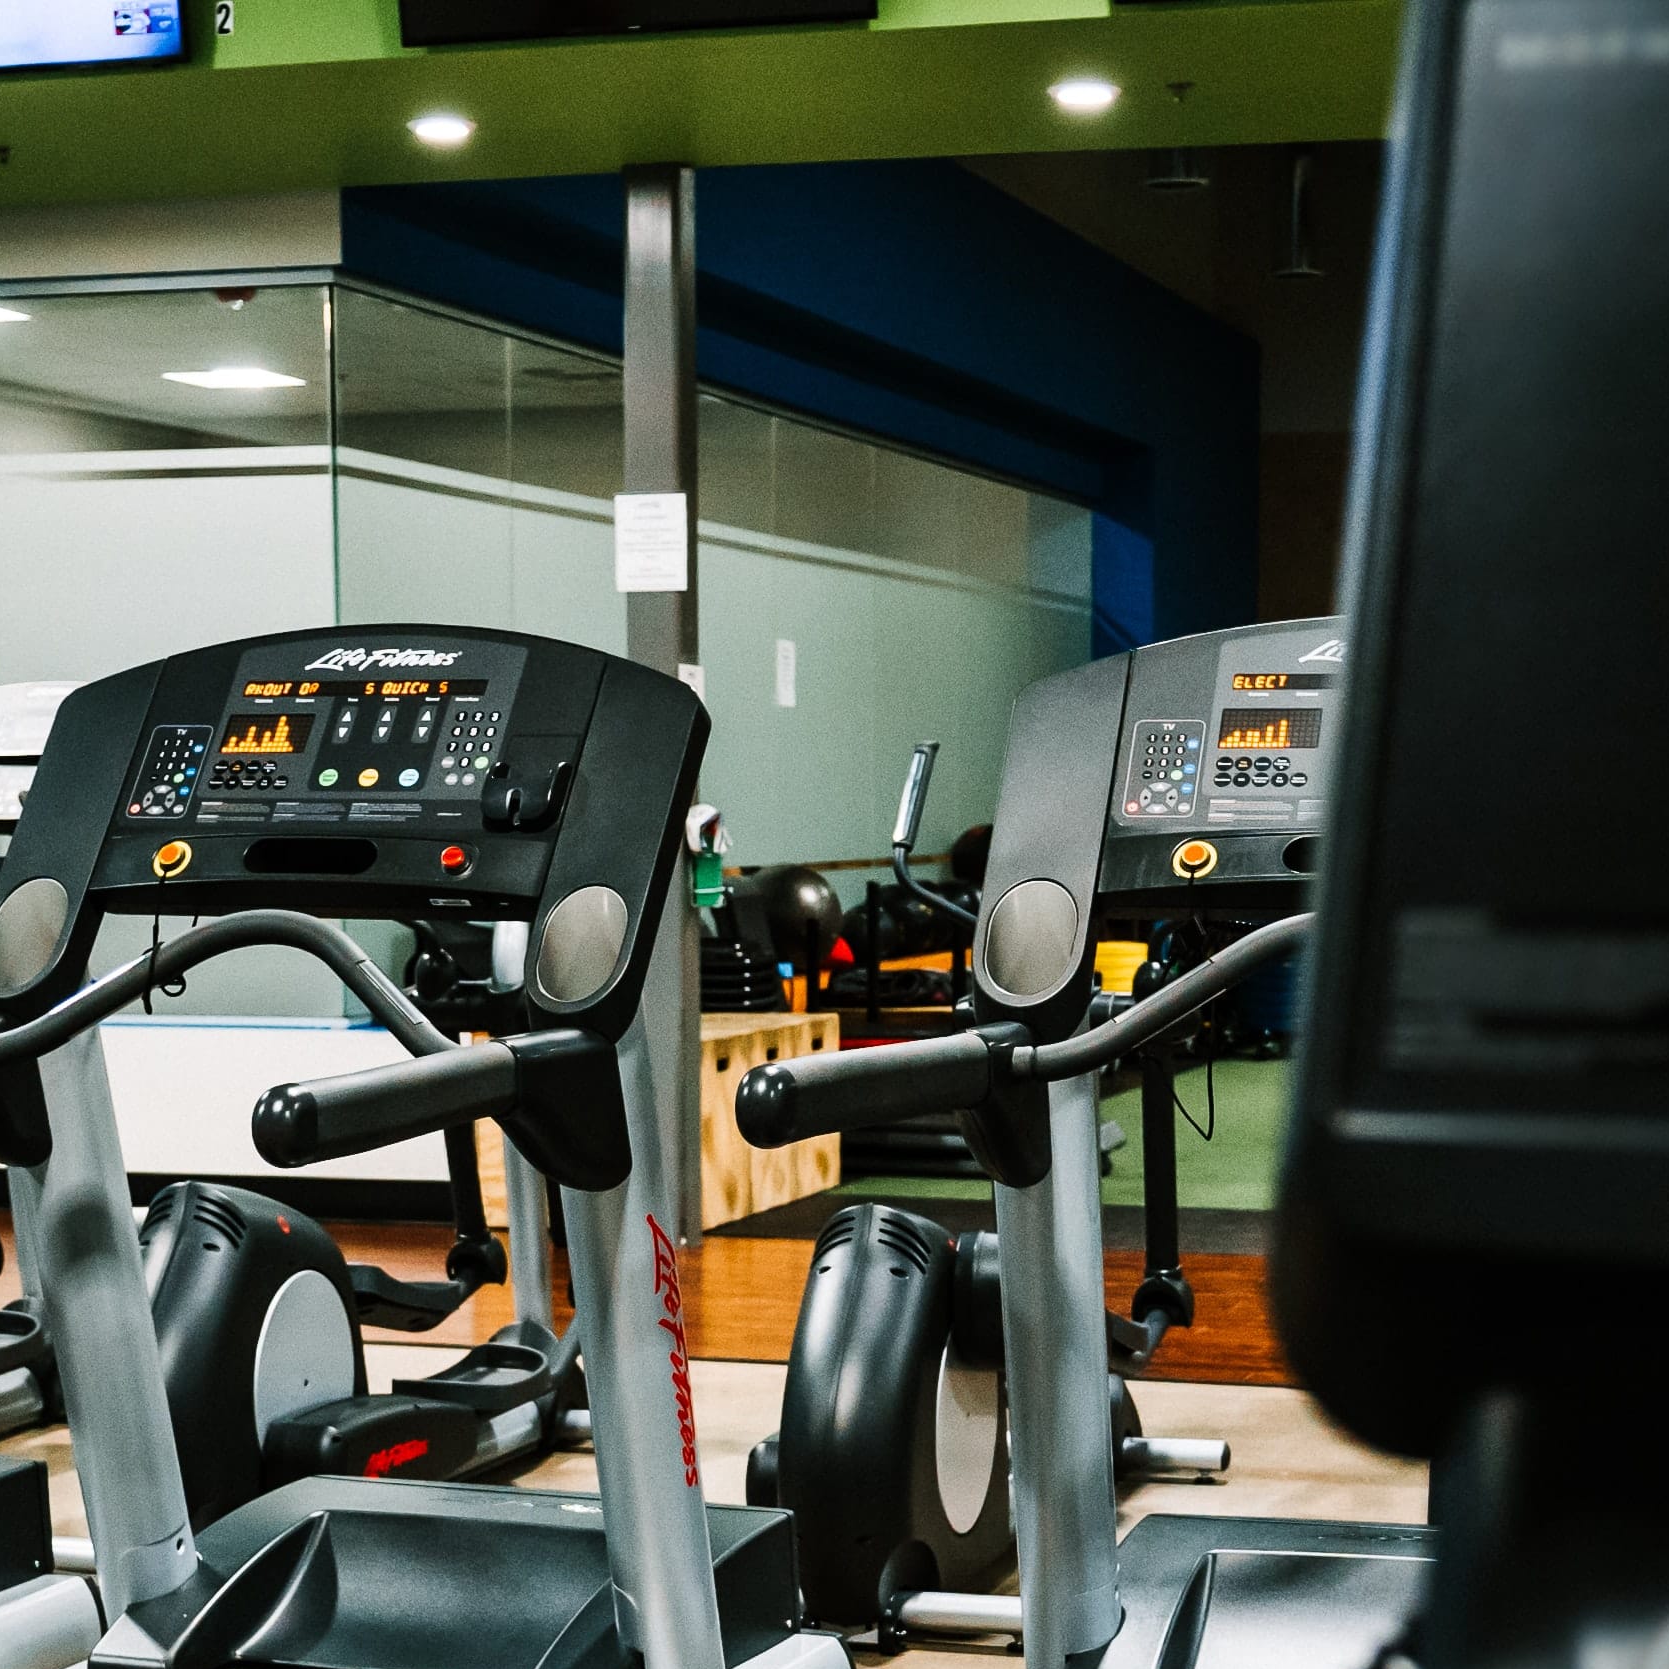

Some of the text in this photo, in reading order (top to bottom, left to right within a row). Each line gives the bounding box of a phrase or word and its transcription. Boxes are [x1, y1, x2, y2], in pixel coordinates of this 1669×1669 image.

[216, 4, 231, 34] 2
[1162, 723, 1175, 731] TV
[646, 1213, 699, 1487] Life Fitness
